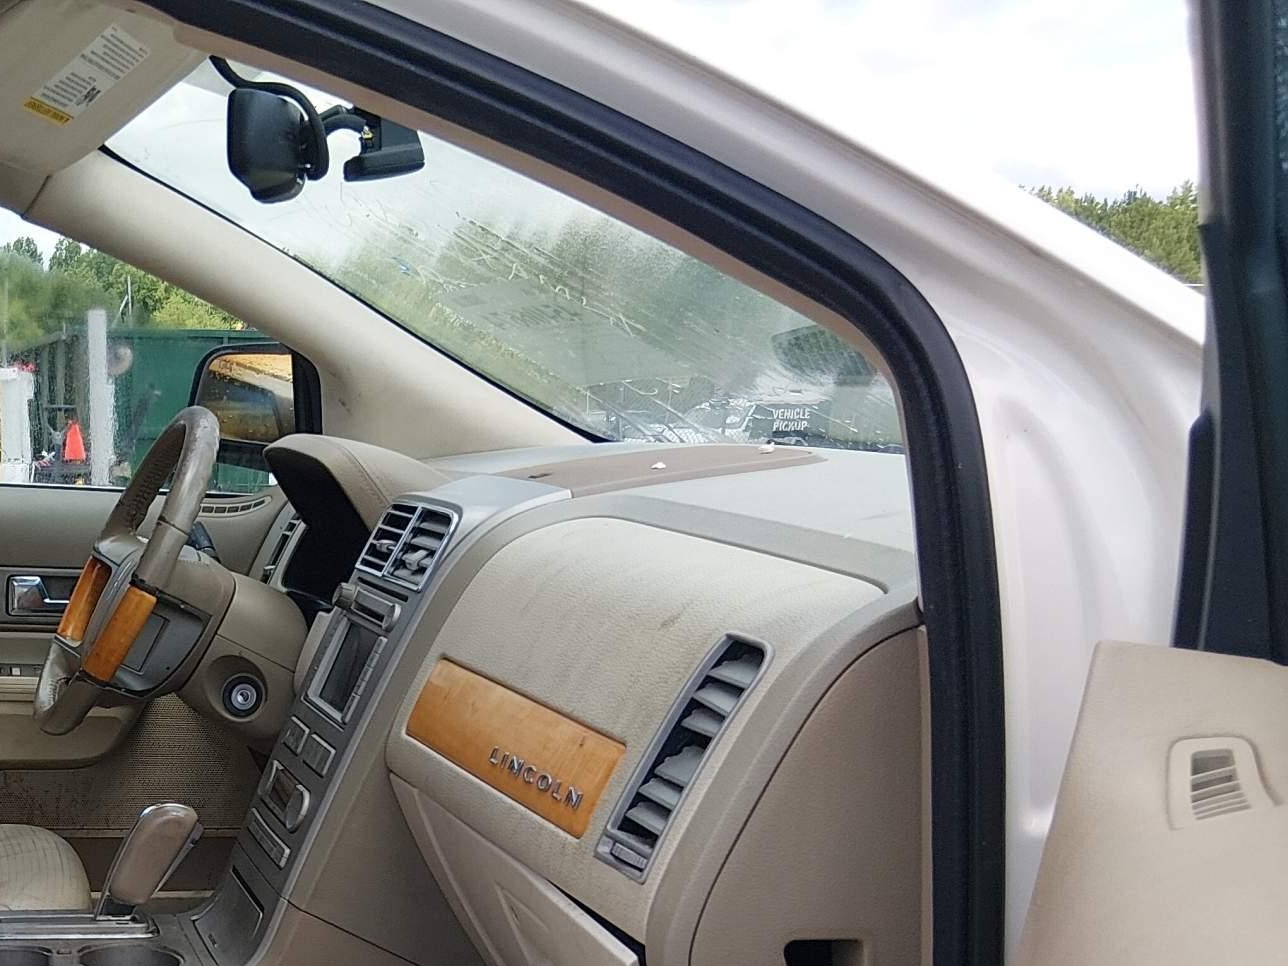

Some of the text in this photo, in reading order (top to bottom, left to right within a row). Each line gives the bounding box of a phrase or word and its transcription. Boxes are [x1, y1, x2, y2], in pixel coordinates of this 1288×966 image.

[772, 408, 811, 420] VEHICLE
[772, 420, 809, 432] PICKUP
[488, 746, 584, 811] LINCOLN
